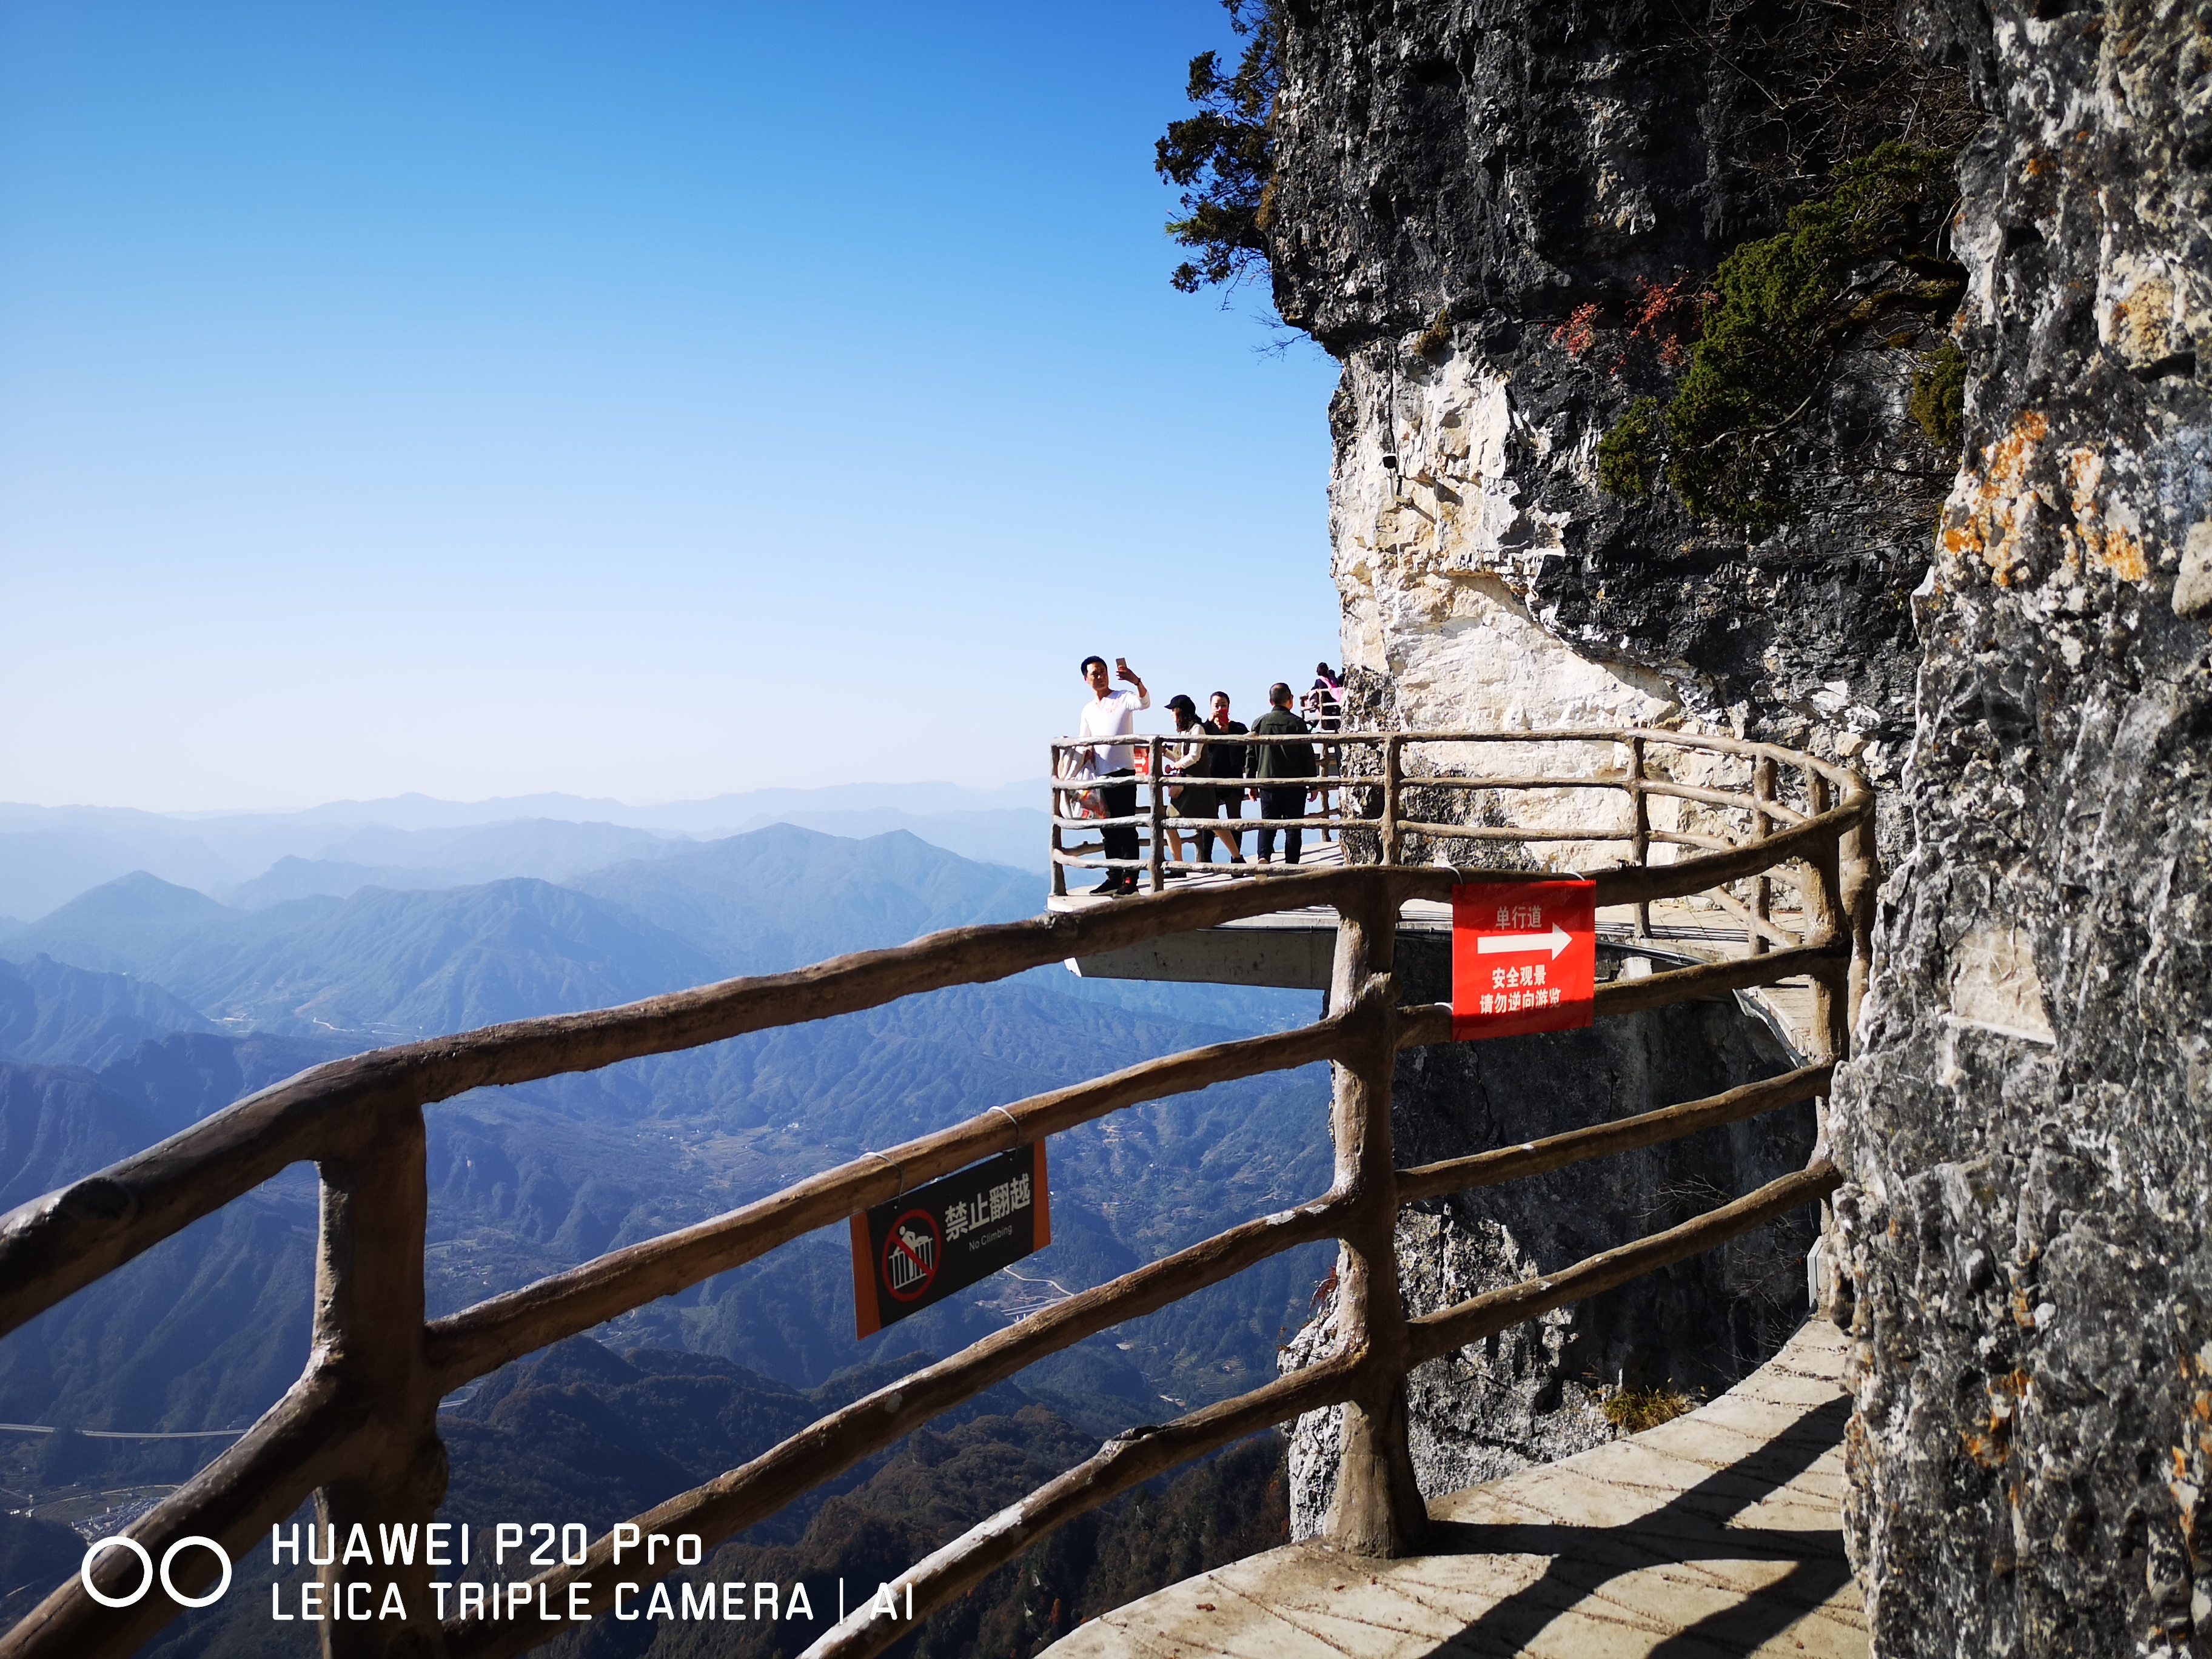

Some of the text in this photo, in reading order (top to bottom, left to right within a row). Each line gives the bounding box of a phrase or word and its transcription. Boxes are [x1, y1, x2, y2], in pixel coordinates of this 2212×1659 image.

[1495, 905, 1542, 930] 单行道
[1492, 964, 1546, 990] 安全观景
[1480, 987, 1561, 1015] 请勿逆向游览
[945, 1173, 1031, 1242] 禁止翻越
[968, 1224, 1013, 1252] No Climbing
